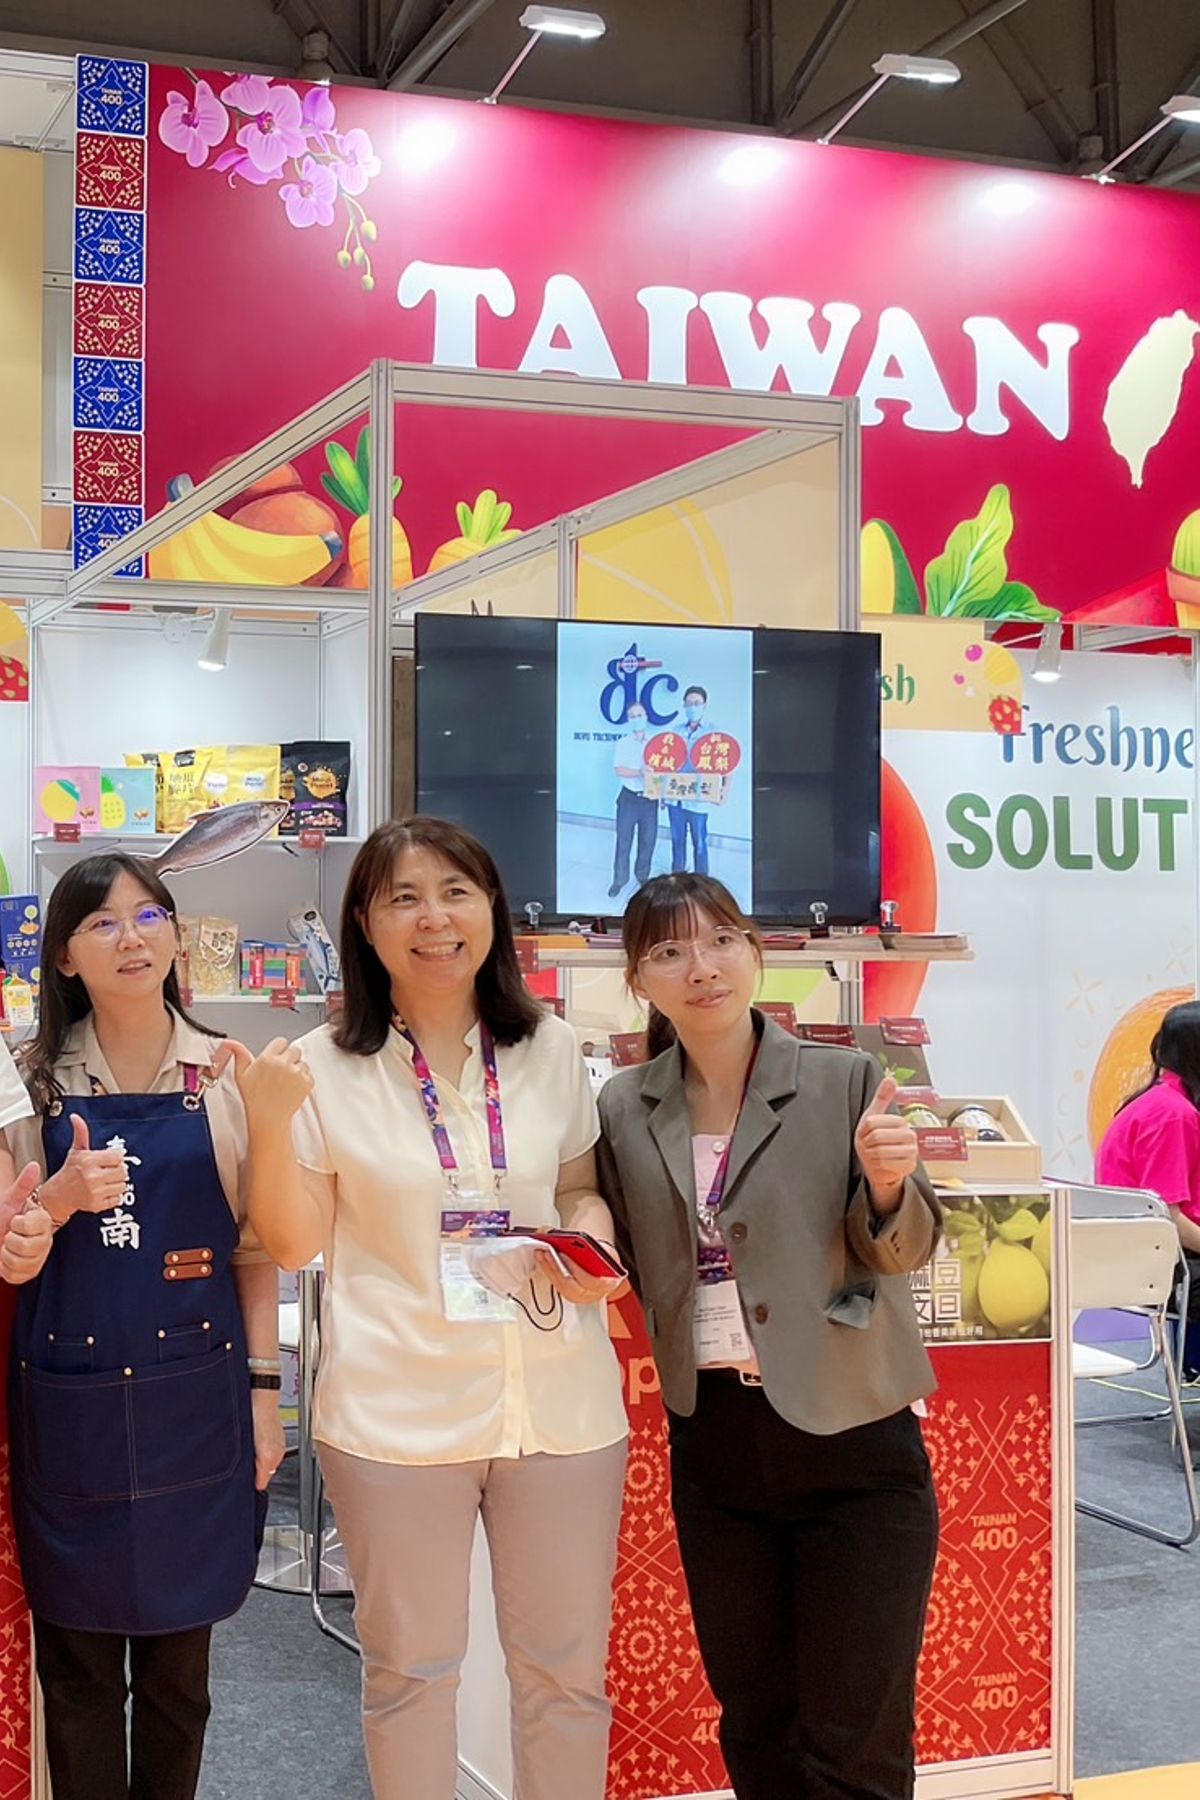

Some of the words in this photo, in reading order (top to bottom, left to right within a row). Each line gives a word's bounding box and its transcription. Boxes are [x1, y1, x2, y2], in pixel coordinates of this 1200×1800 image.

[101, 94, 123, 105] 400
[100, 170, 121, 181] 400
[100, 244, 120, 254] 400
[99, 319, 120, 329] 400
[397, 260, 1080, 441] TAIWAN
[98, 392, 119, 402] 400
[98, 466, 119, 477] 400
[880, 664, 916, 704] sh
[946, 792, 1189, 871] SOLUT
[100, 1208, 140, 1250] 南
[970, 1512, 1017, 1528] TAINAN
[970, 1527, 1018, 1551] 400
[971, 1672, 1018, 1687] TAINAN
[971, 1686, 1018, 1711] 400
[691, 1705, 721, 1720] TAIN
[691, 1720, 720, 1745] 40
